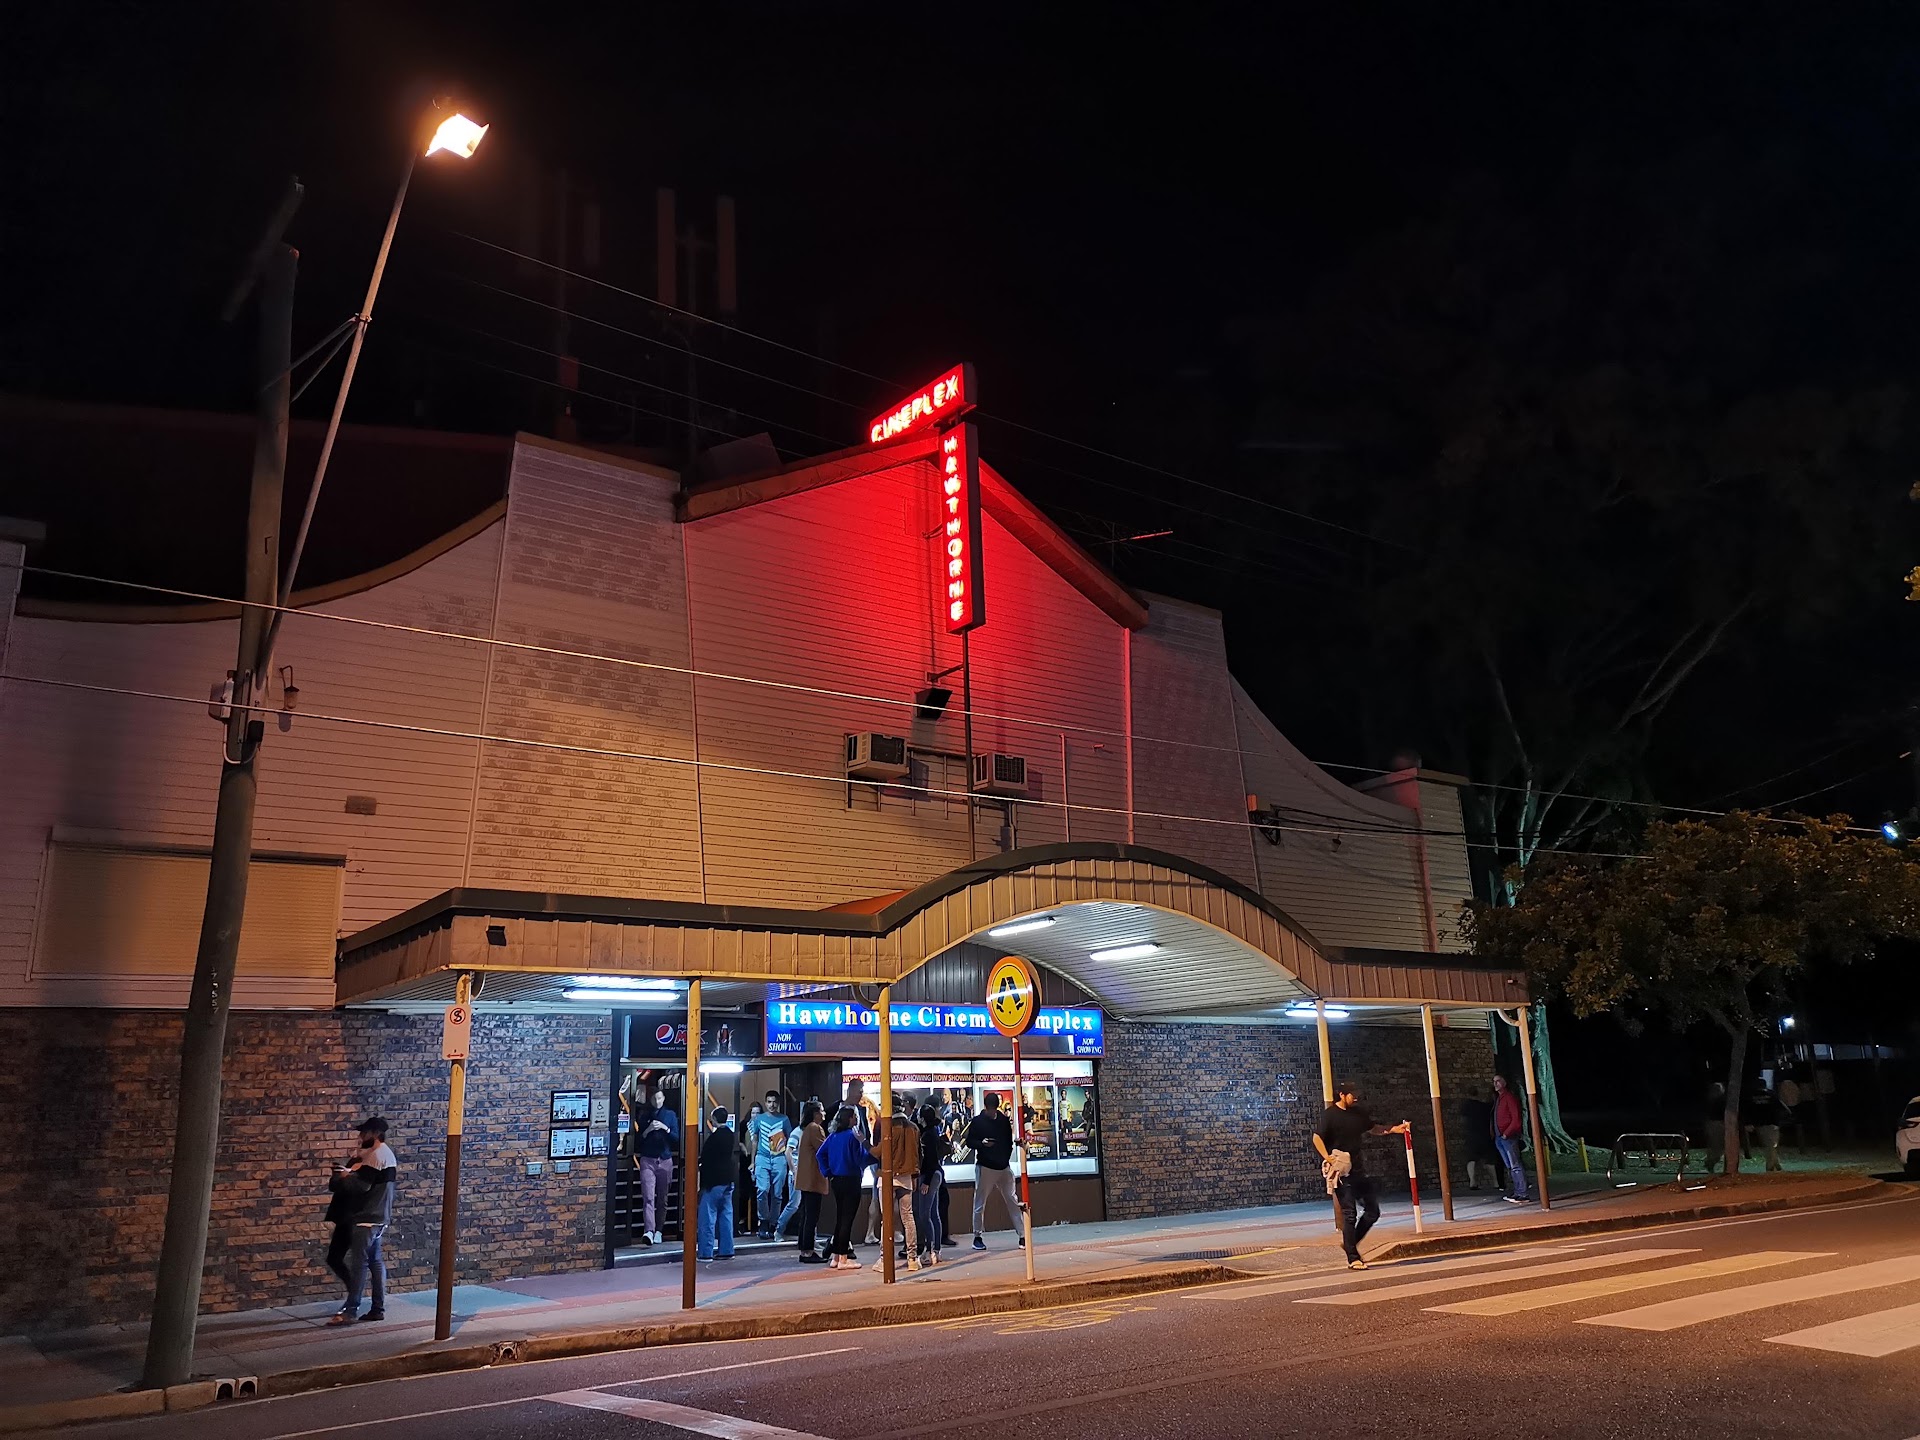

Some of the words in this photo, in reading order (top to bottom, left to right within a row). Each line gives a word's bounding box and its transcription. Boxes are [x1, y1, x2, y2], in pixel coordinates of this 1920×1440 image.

[871, 374, 959, 443] CINEPLEX
[944, 435, 964, 621] HAWTHORNE
[1035, 1011, 1093, 1034] mplex
[776, 1033, 793, 1042] NOW
[1081, 1037, 1095, 1046] NOW
[768, 1042, 802, 1052] SHOWING
[1076, 1045, 1102, 1054] SHOWING
[904, 1074, 931, 1082] SHOWING
[934, 1074, 948, 1082] NOW
[948, 1074, 974, 1082] SHOWING
[976, 1074, 989, 1082] NOW
[1069, 1077, 1093, 1085] SHOWING
